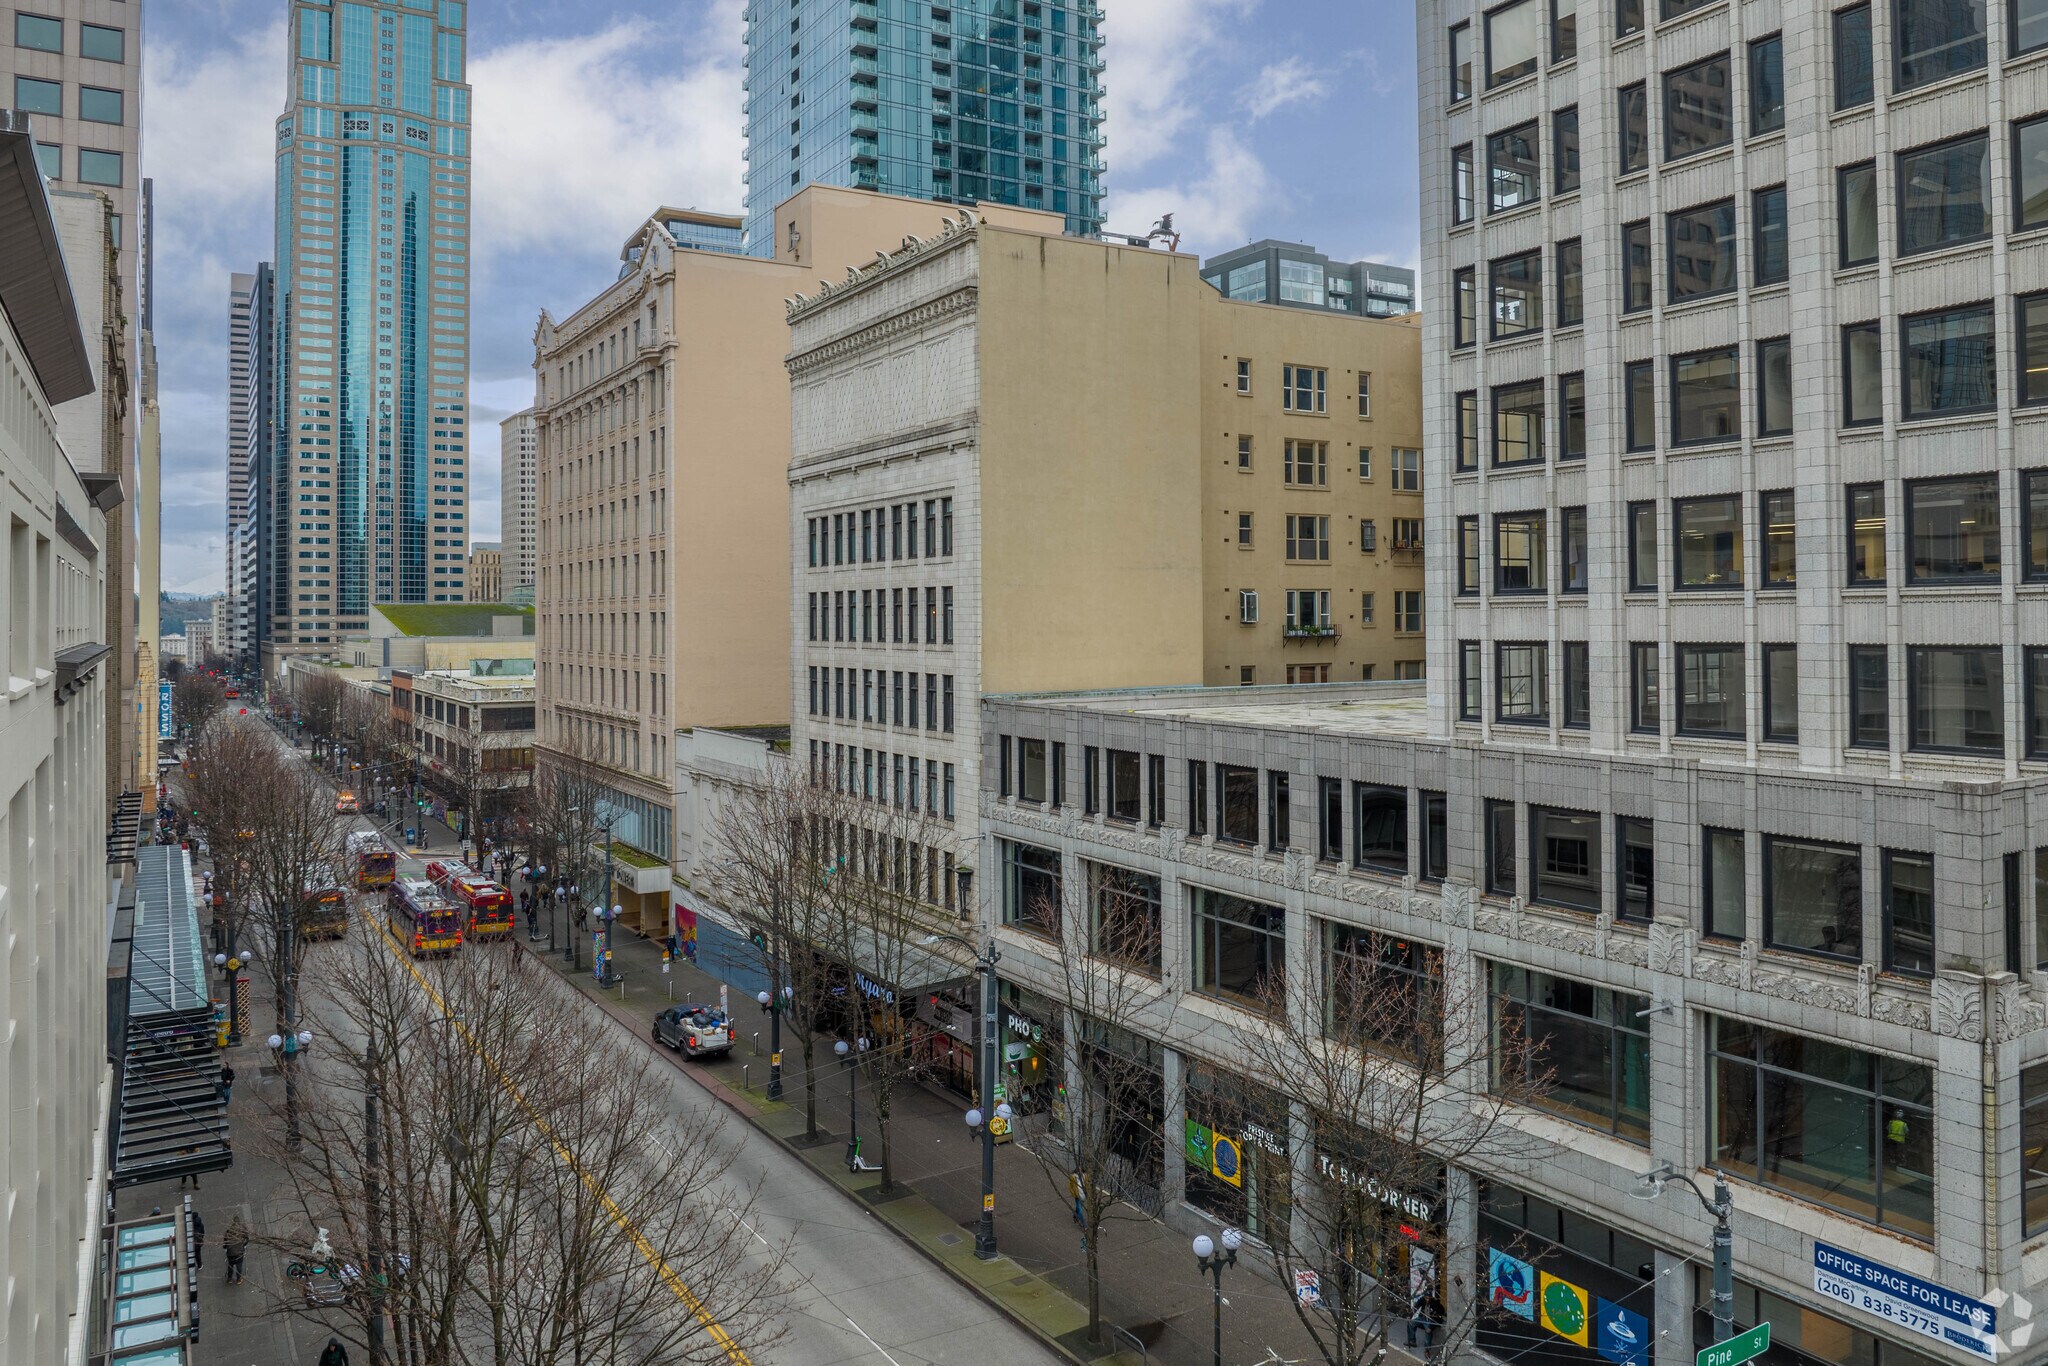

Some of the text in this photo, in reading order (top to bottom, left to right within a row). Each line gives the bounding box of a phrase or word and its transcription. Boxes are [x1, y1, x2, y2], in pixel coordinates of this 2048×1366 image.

[161, 692, 170, 732] ROSS
[1008, 1014, 1030, 1037] PHO
[1817, 1270, 1869, 1295] Damon McCartney
[1817, 1250, 1992, 1326] OFFICE SPACE FOR LEASE
[1817, 1277, 1939, 1335] (206) 838-5775
[1885, 1296, 1939, 1322] David Greenwood
[1708, 1337, 1762, 1366] Pine St
